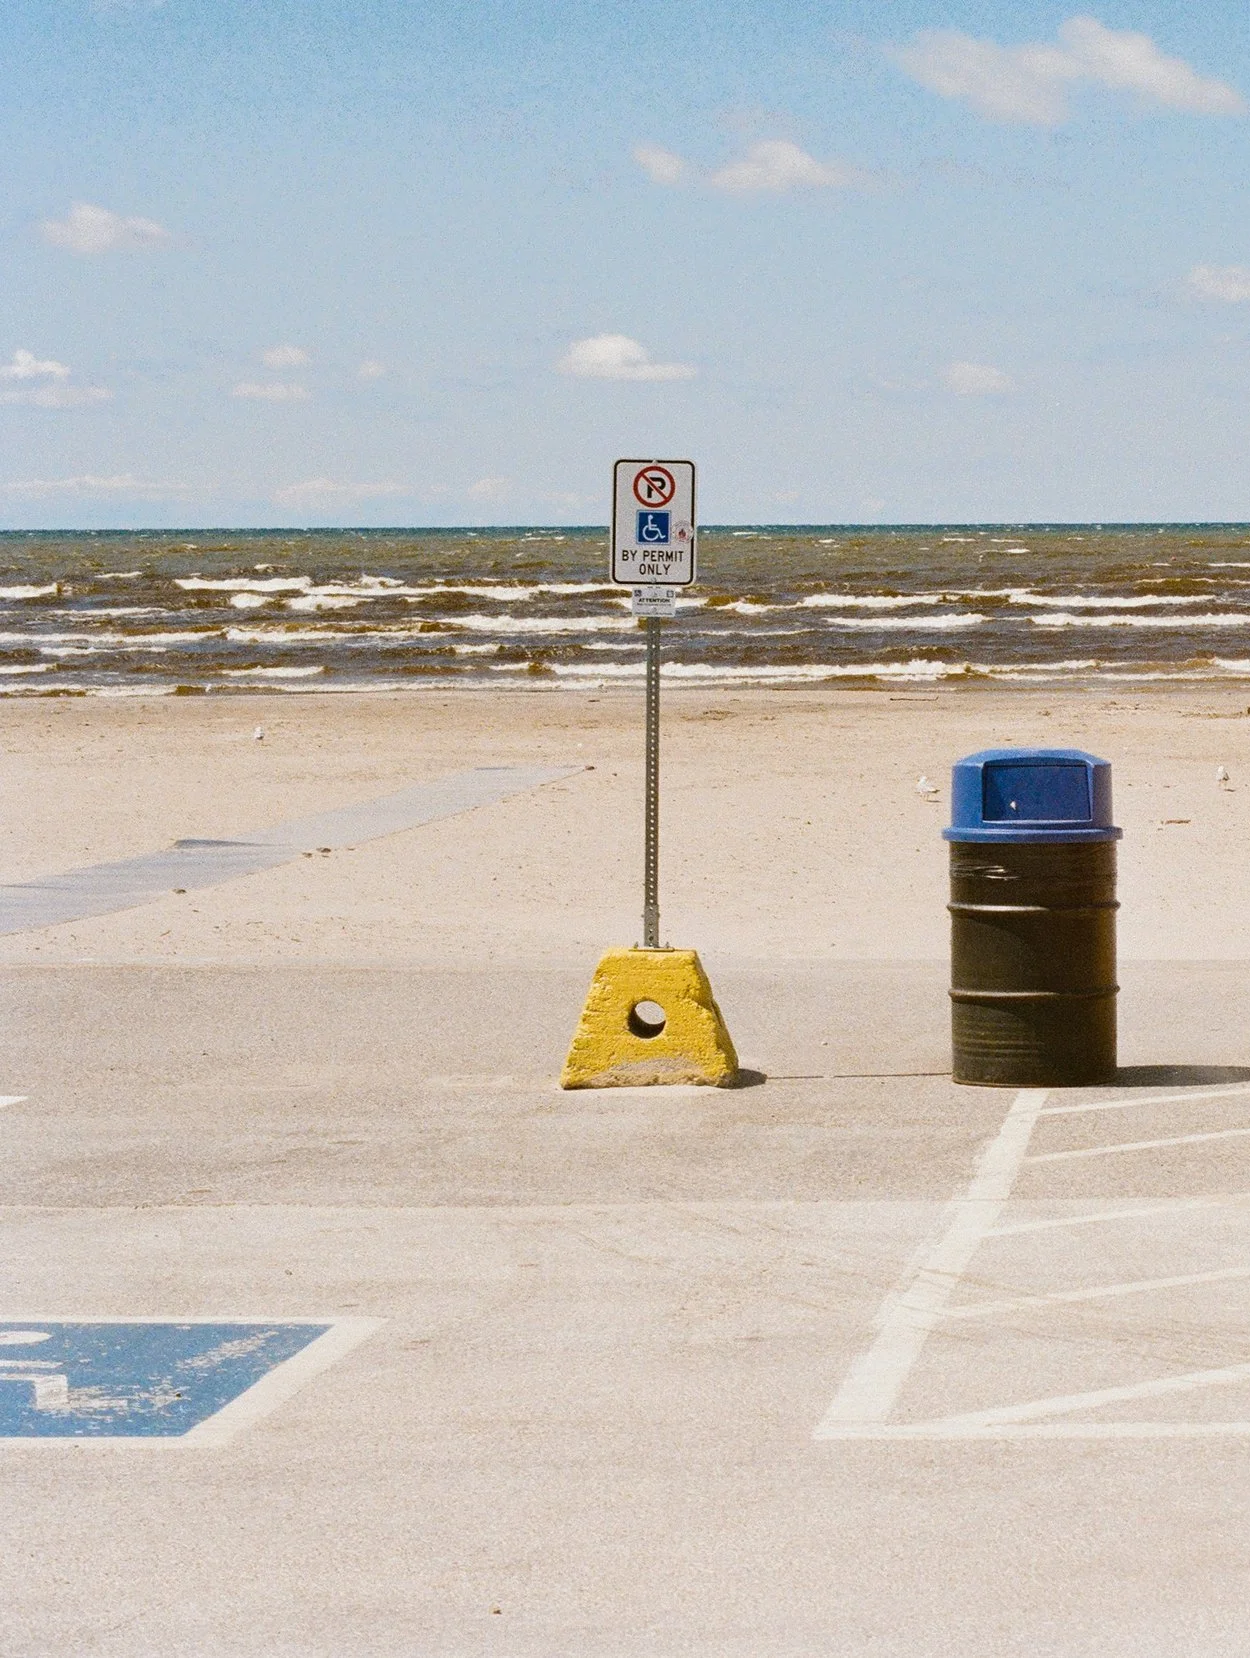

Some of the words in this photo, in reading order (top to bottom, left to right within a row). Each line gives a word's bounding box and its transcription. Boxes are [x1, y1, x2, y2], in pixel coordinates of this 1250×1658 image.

[647, 477, 666, 498] P
[622, 550, 638, 562] BY
[643, 550, 684, 562] PERMIT
[639, 563, 671, 575] ONLY
